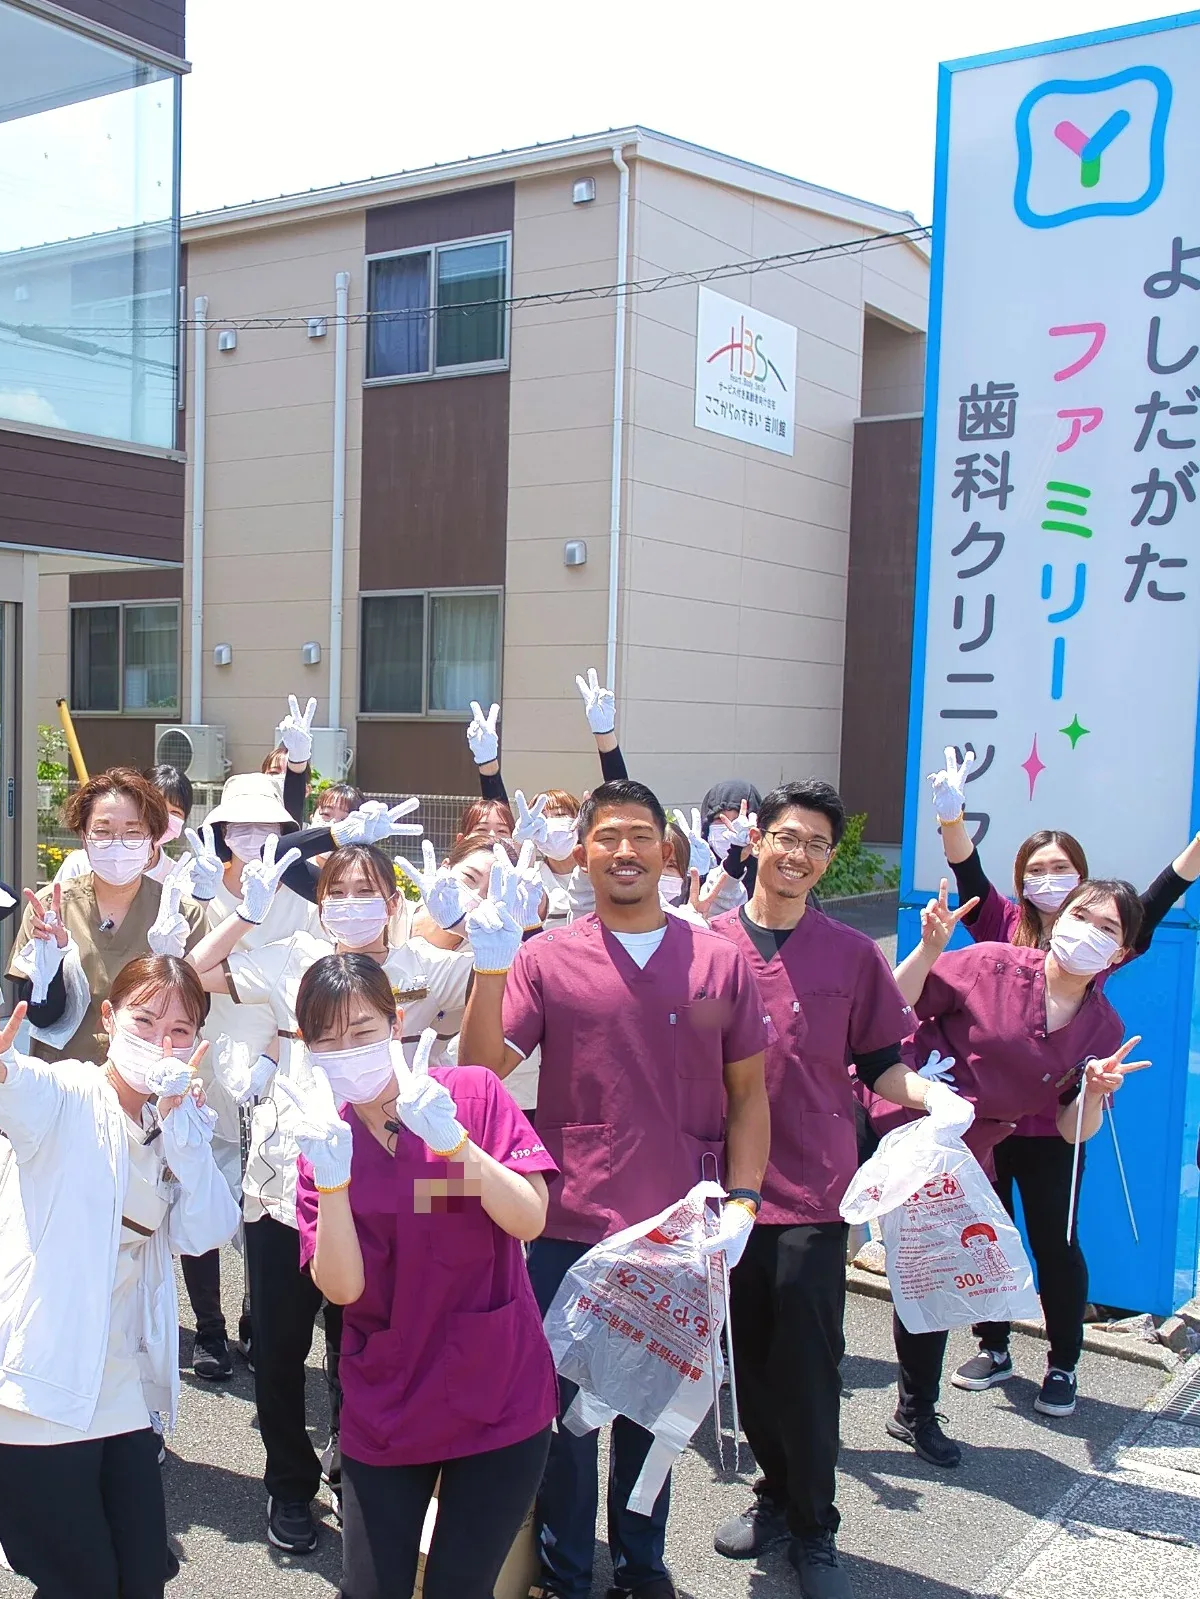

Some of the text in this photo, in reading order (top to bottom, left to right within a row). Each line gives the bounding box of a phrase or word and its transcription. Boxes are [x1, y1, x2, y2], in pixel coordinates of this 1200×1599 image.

[1124, 236, 1200, 603] よしだがた
[1040, 322, 1107, 701] ファミリー
[577, 1294, 646, 1344] 家庭用ごみ袋
[616, 1267, 710, 1338] もやすごみ
[646, 1337, 704, 1382] 豊橋市指定
